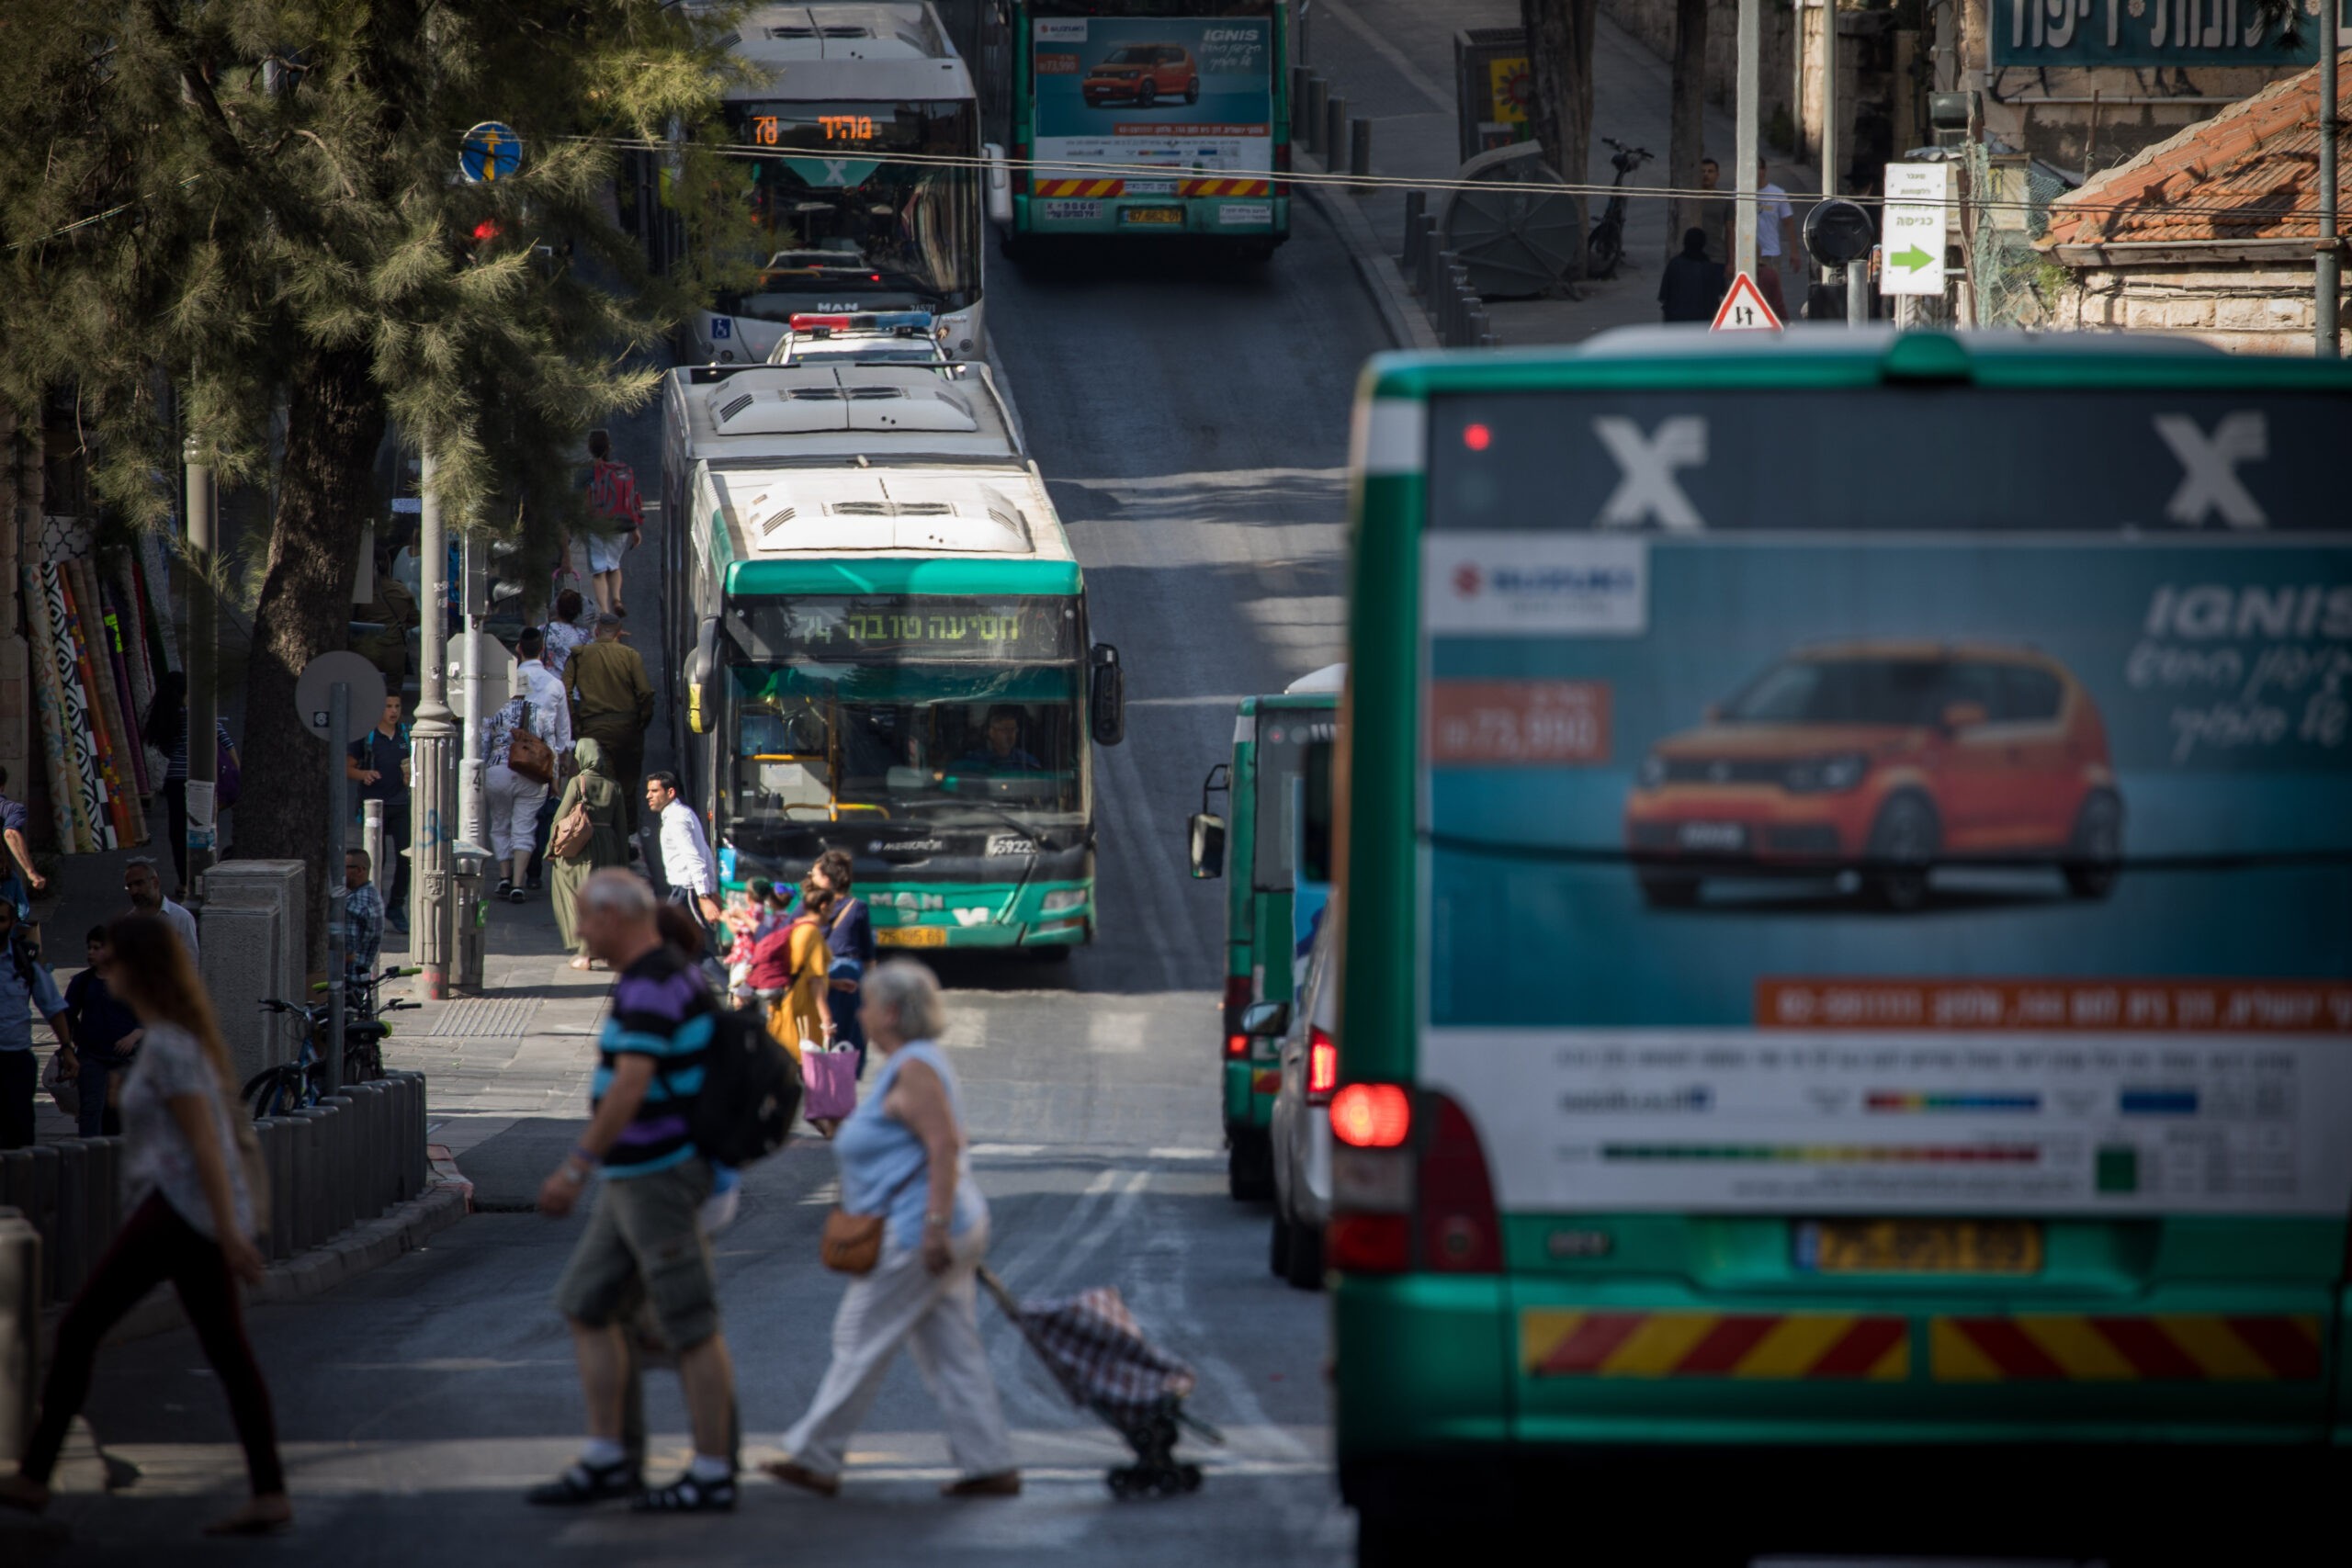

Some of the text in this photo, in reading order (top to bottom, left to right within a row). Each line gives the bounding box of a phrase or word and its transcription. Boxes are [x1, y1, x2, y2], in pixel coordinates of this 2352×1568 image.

[1204, 28, 1260, 42] IGNIS
[752, 116, 778, 145] 78
[1896, 216, 1934, 226] כניסה
[818, 303, 859, 312] MAN
[850, 616, 922, 640] טובה
[869, 891, 944, 910] MAN
